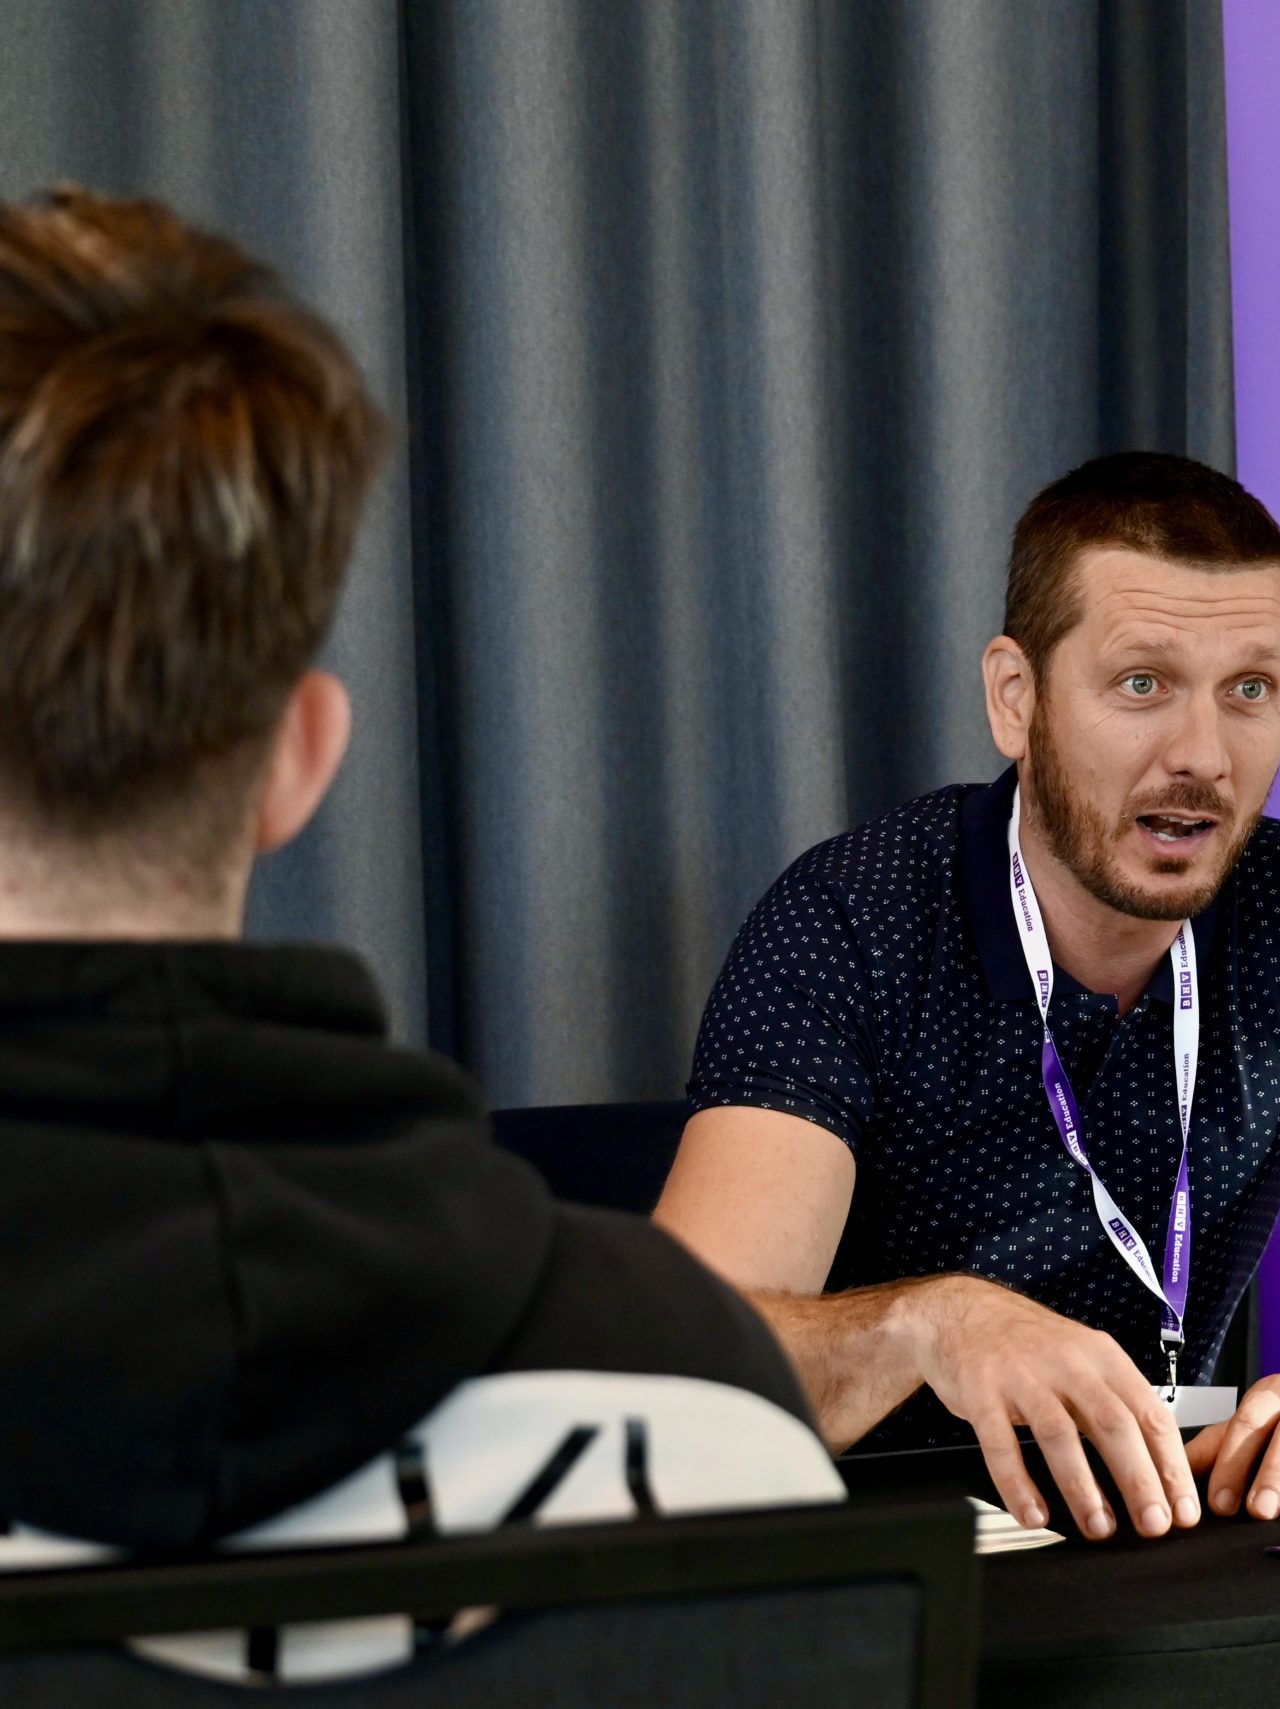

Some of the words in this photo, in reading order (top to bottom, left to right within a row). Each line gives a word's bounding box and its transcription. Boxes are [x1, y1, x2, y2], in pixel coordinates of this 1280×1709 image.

[1018, 888, 1033, 932] Education
[1180, 971, 1192, 1009] BHV
[1054, 1082, 1074, 1130] Education
[1108, 1217, 1137, 1251] BHV
[1171, 1233, 1183, 1283] Education
